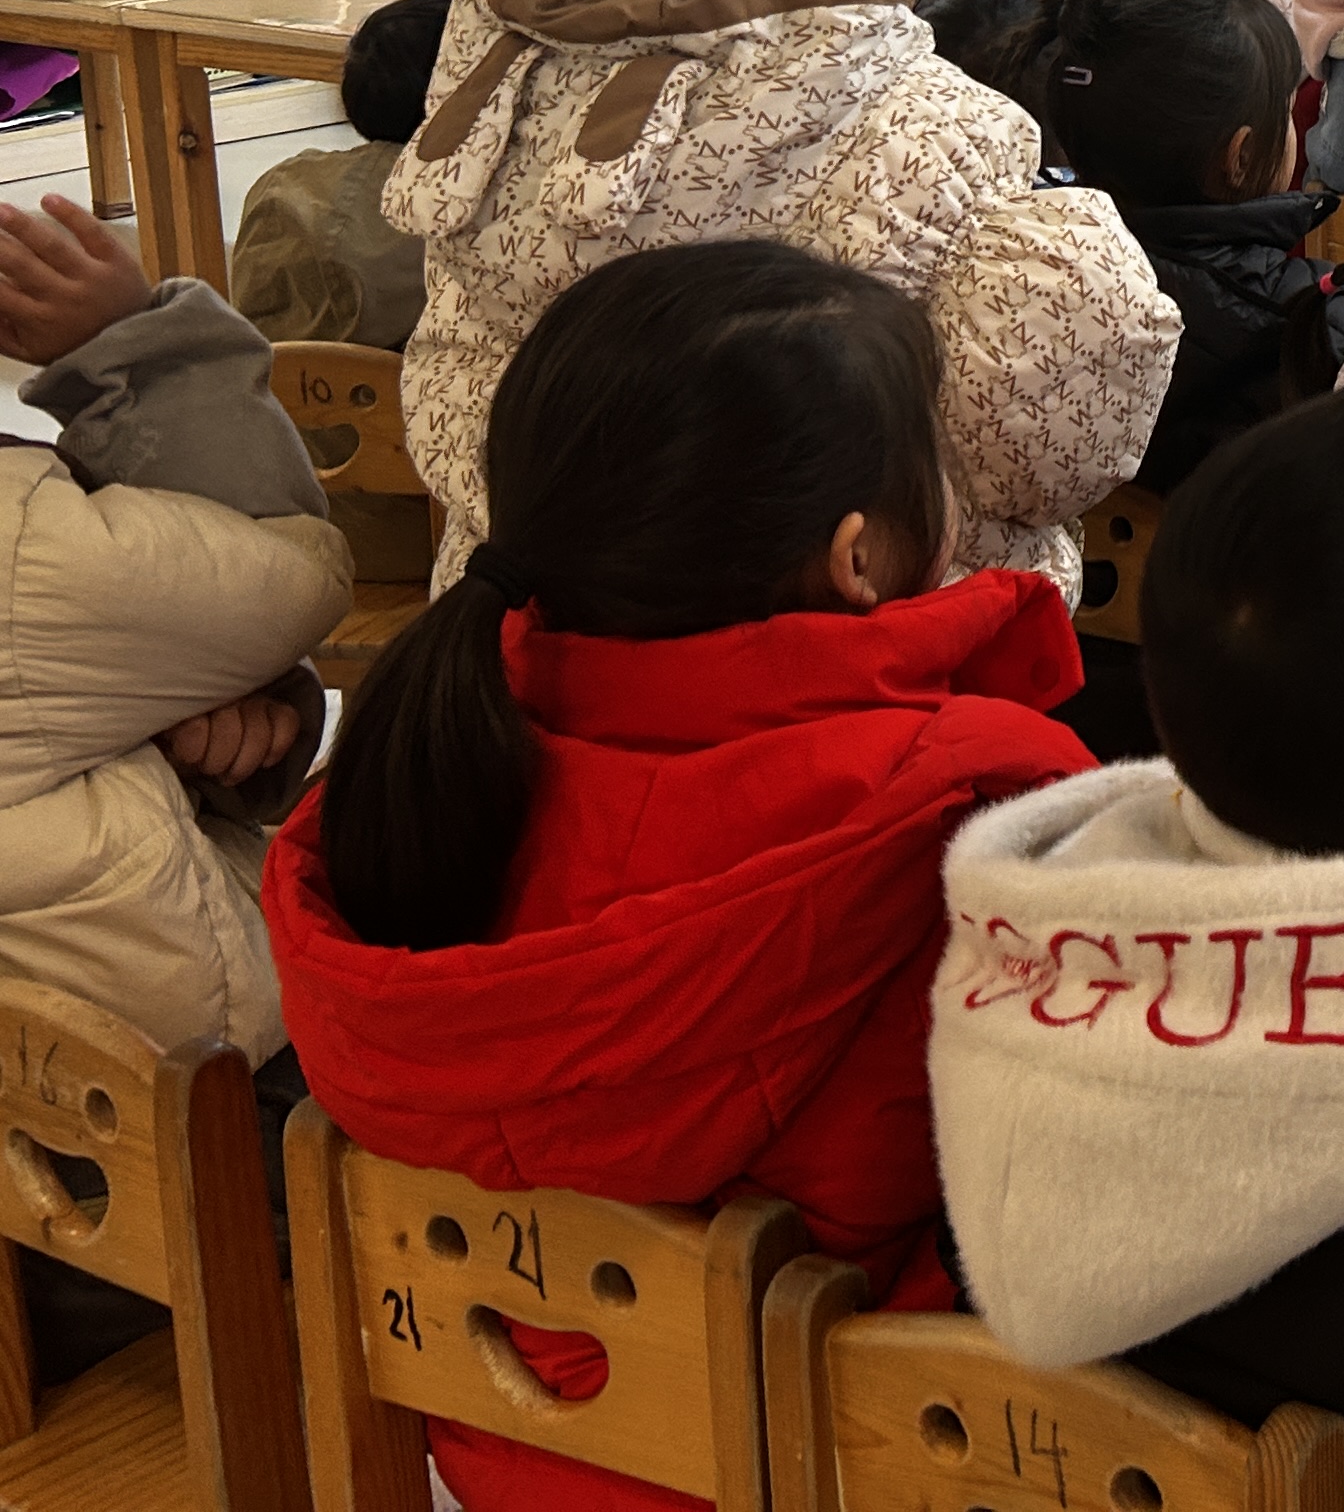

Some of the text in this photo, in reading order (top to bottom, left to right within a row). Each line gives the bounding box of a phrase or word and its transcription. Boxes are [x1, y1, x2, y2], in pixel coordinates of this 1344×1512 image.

[300, 370, 333, 404] 10
[18, 1025, 59, 1106] 16
[492, 1208, 547, 1301] 21
[382, 1286, 422, 1352] 21
[1006, 1399, 1068, 1509] 14
